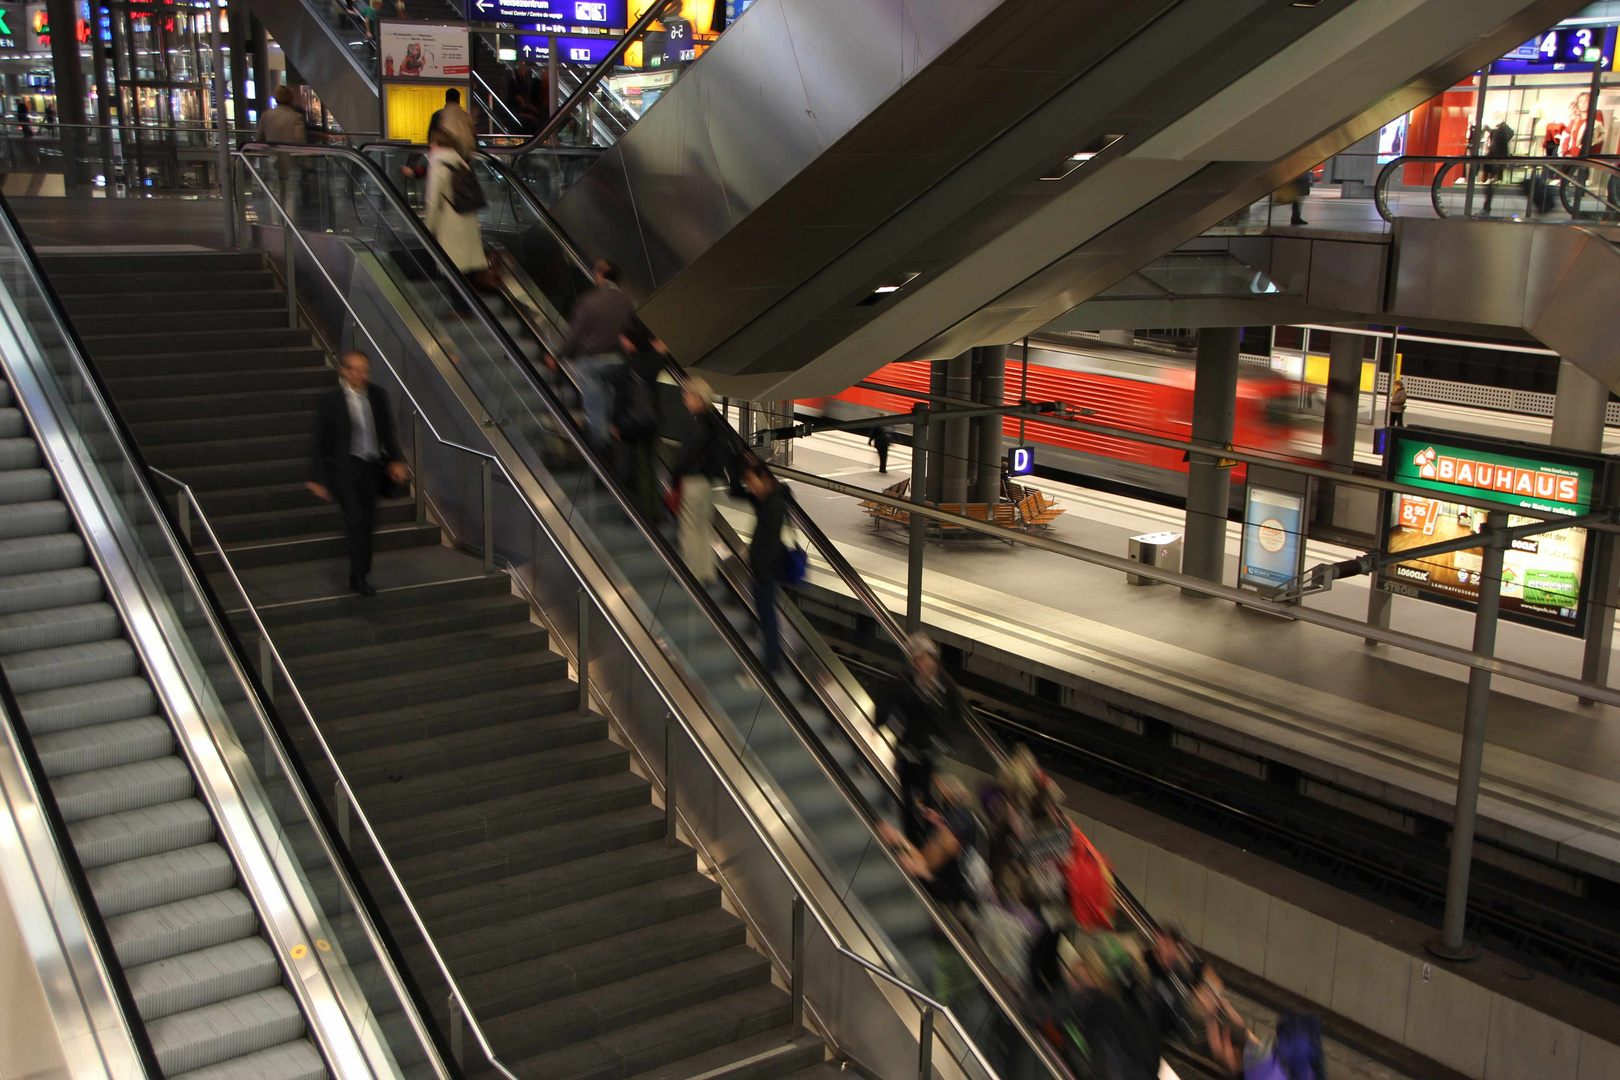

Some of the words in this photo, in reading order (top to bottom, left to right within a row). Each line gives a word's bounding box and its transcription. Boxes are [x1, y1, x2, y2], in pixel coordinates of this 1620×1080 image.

[1540, 31, 1557, 57] 4
[1015, 448, 1028, 471] D
[1438, 457, 1576, 501] BAUHAUS
[1397, 567, 1429, 581] LOGOCLIC
